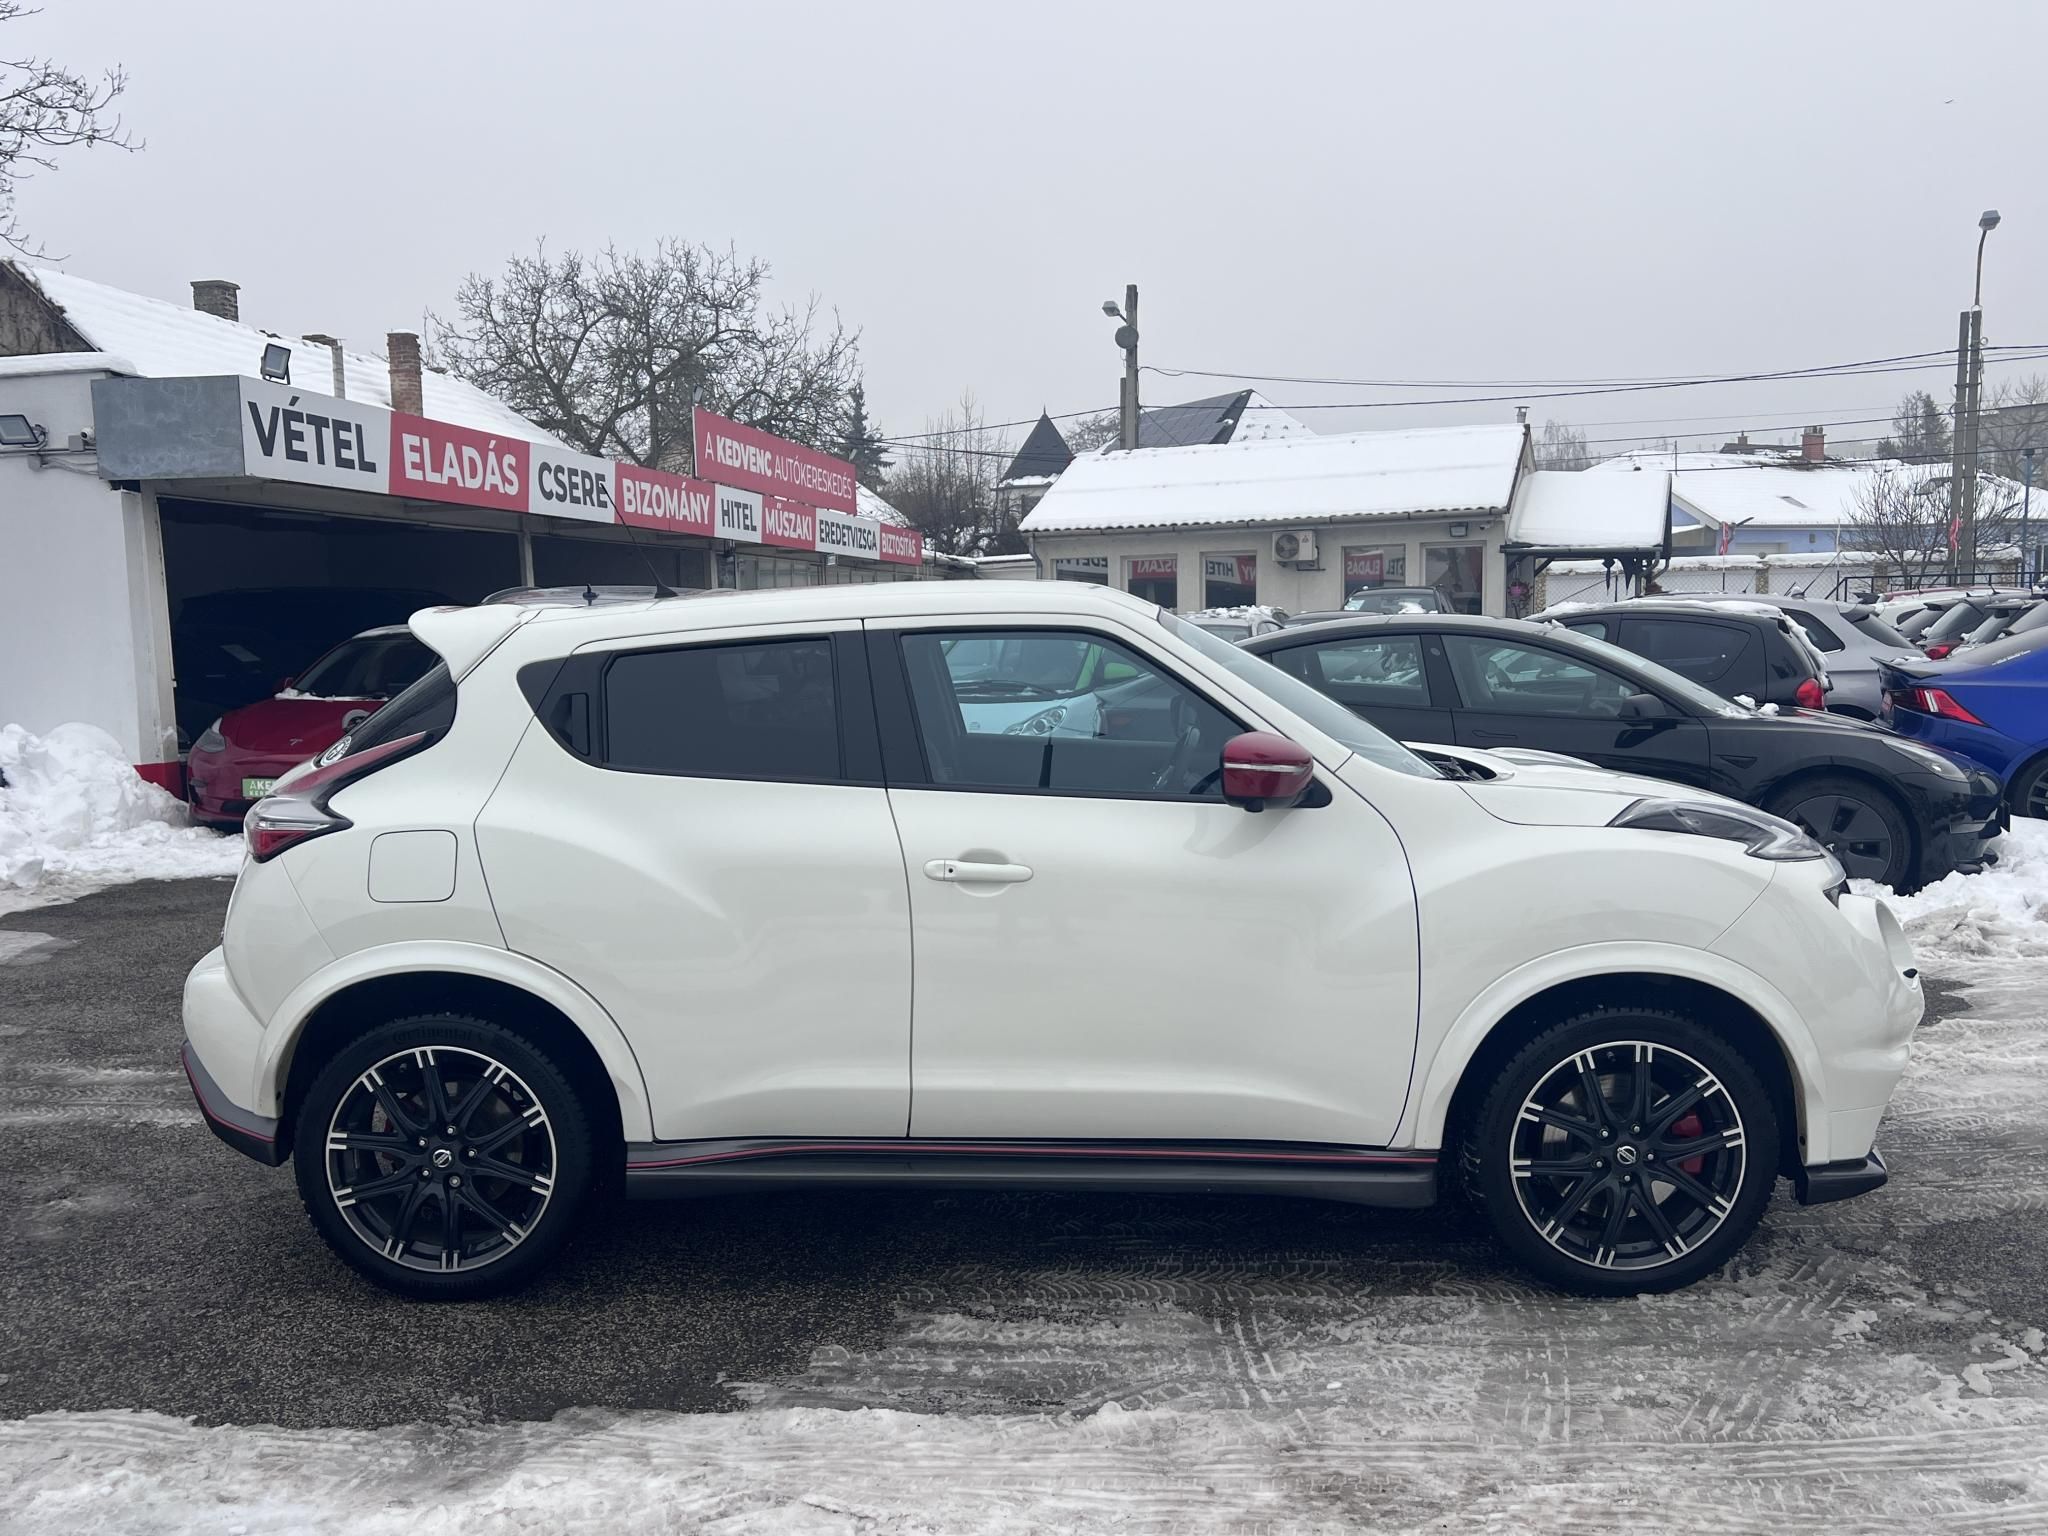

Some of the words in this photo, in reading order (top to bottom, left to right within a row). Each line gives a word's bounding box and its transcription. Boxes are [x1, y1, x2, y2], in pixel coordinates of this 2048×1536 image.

[248, 395, 376, 473] VÉTEL
[401, 433, 519, 496] ELADÁS
[538, 461, 608, 508] CSERE
[622, 478, 710, 525] BIZOMÁNY
[720, 498, 757, 532] HITEL
[765, 502, 813, 541] MŰSZAKI
[819, 519, 878, 552] EREDETVIZSGA
[881, 532, 916, 558] BIZTOSÍTÁS
[704, 431, 714, 461] A
[716, 434, 772, 478] KEDVENC
[774, 456, 852, 499] AUTÓKERESKEDÉS
